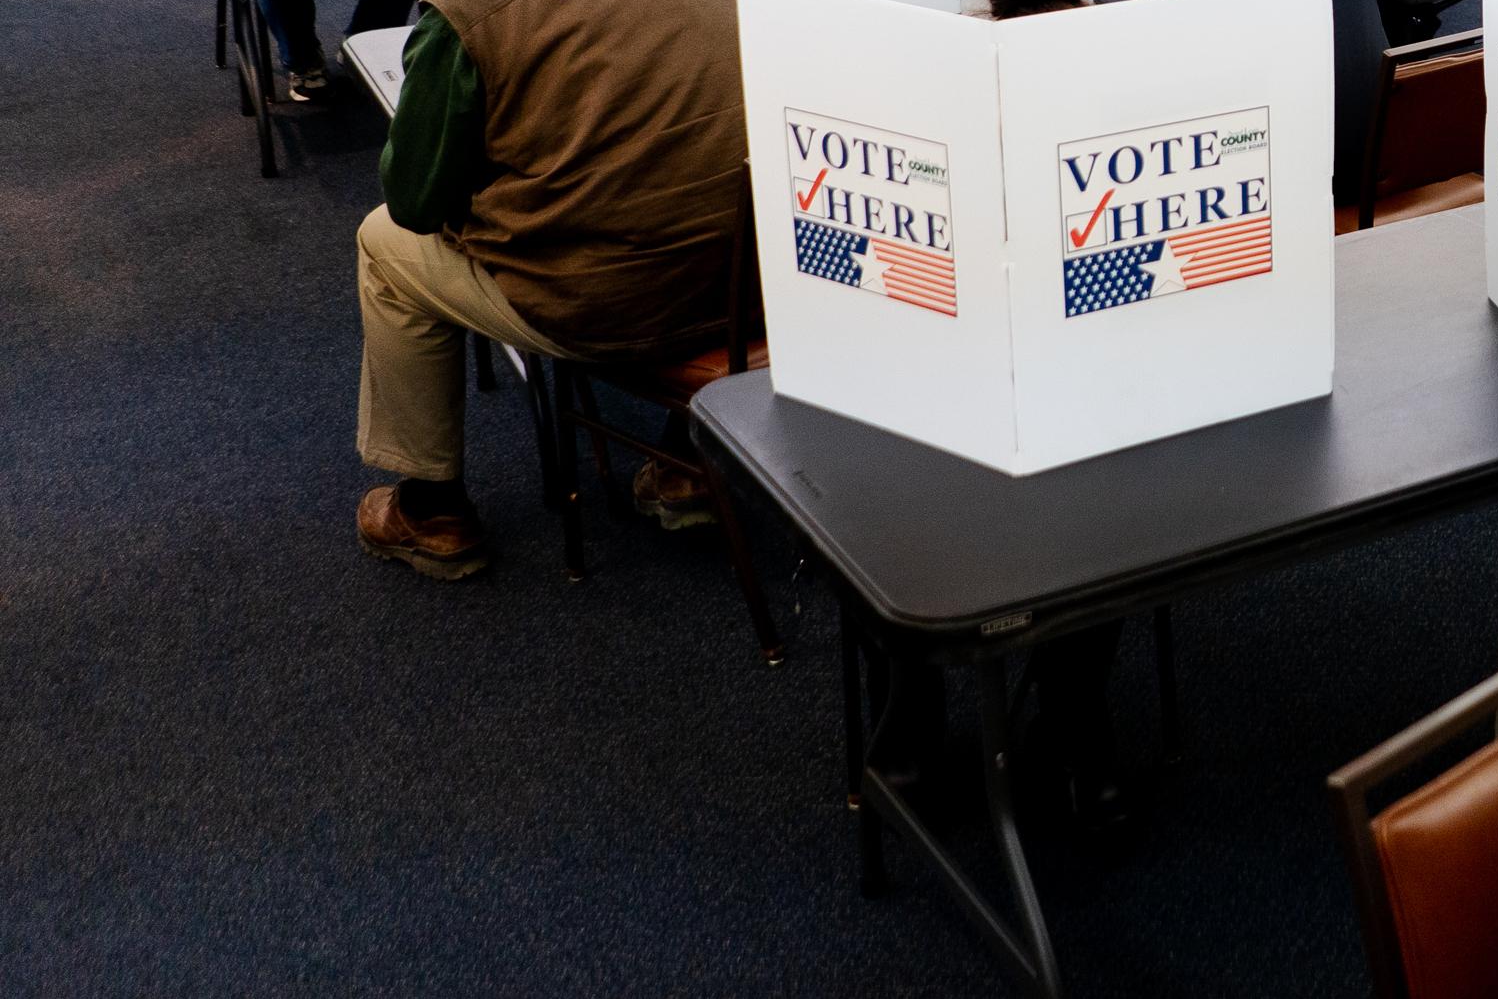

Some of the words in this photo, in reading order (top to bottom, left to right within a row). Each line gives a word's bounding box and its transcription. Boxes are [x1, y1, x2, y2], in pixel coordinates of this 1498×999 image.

[788, 122, 910, 185] VOTE
[909, 160, 946, 178] COUNTY
[1062, 130, 1221, 193] VOTE
[1221, 130, 1266, 147] COUNTY
[824, 185, 951, 251] HERE
[1109, 177, 1267, 243] HERE
